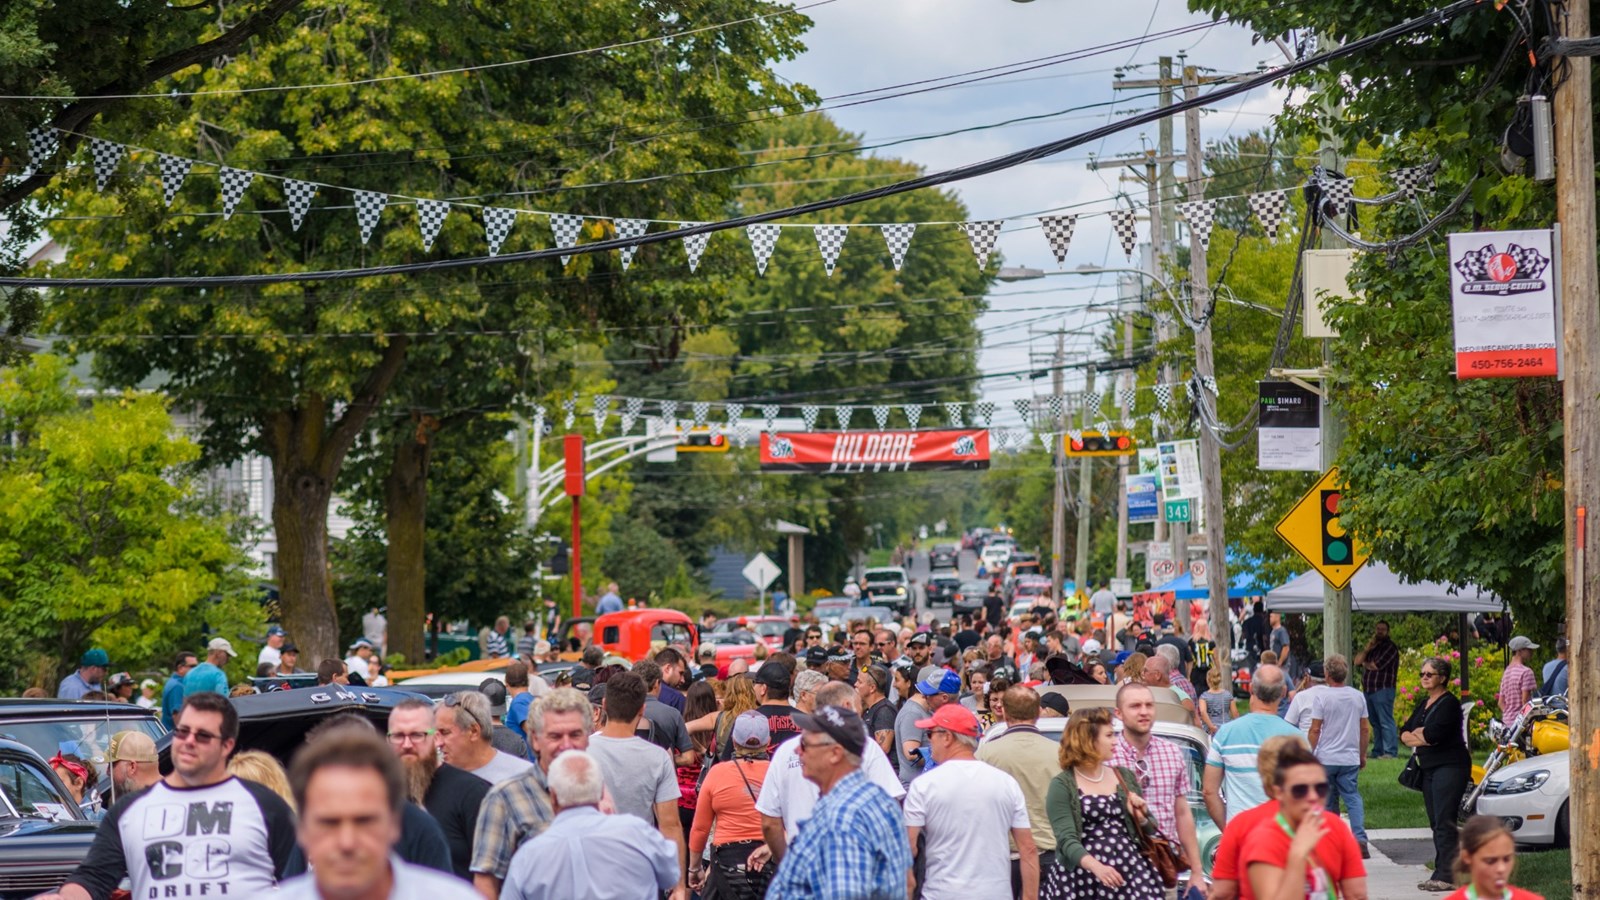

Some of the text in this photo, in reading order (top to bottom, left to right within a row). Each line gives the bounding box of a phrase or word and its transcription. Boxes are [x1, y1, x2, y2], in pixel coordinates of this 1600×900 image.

[1471, 357, 1544, 370] 450-756-2464
[1260, 397, 1302, 405] PAUL SIMARD
[831, 433, 918, 461] KILDARE
[1167, 505, 1188, 518] 343
[310, 691, 381, 705] GMC
[149, 881, 230, 899] DRIFT
